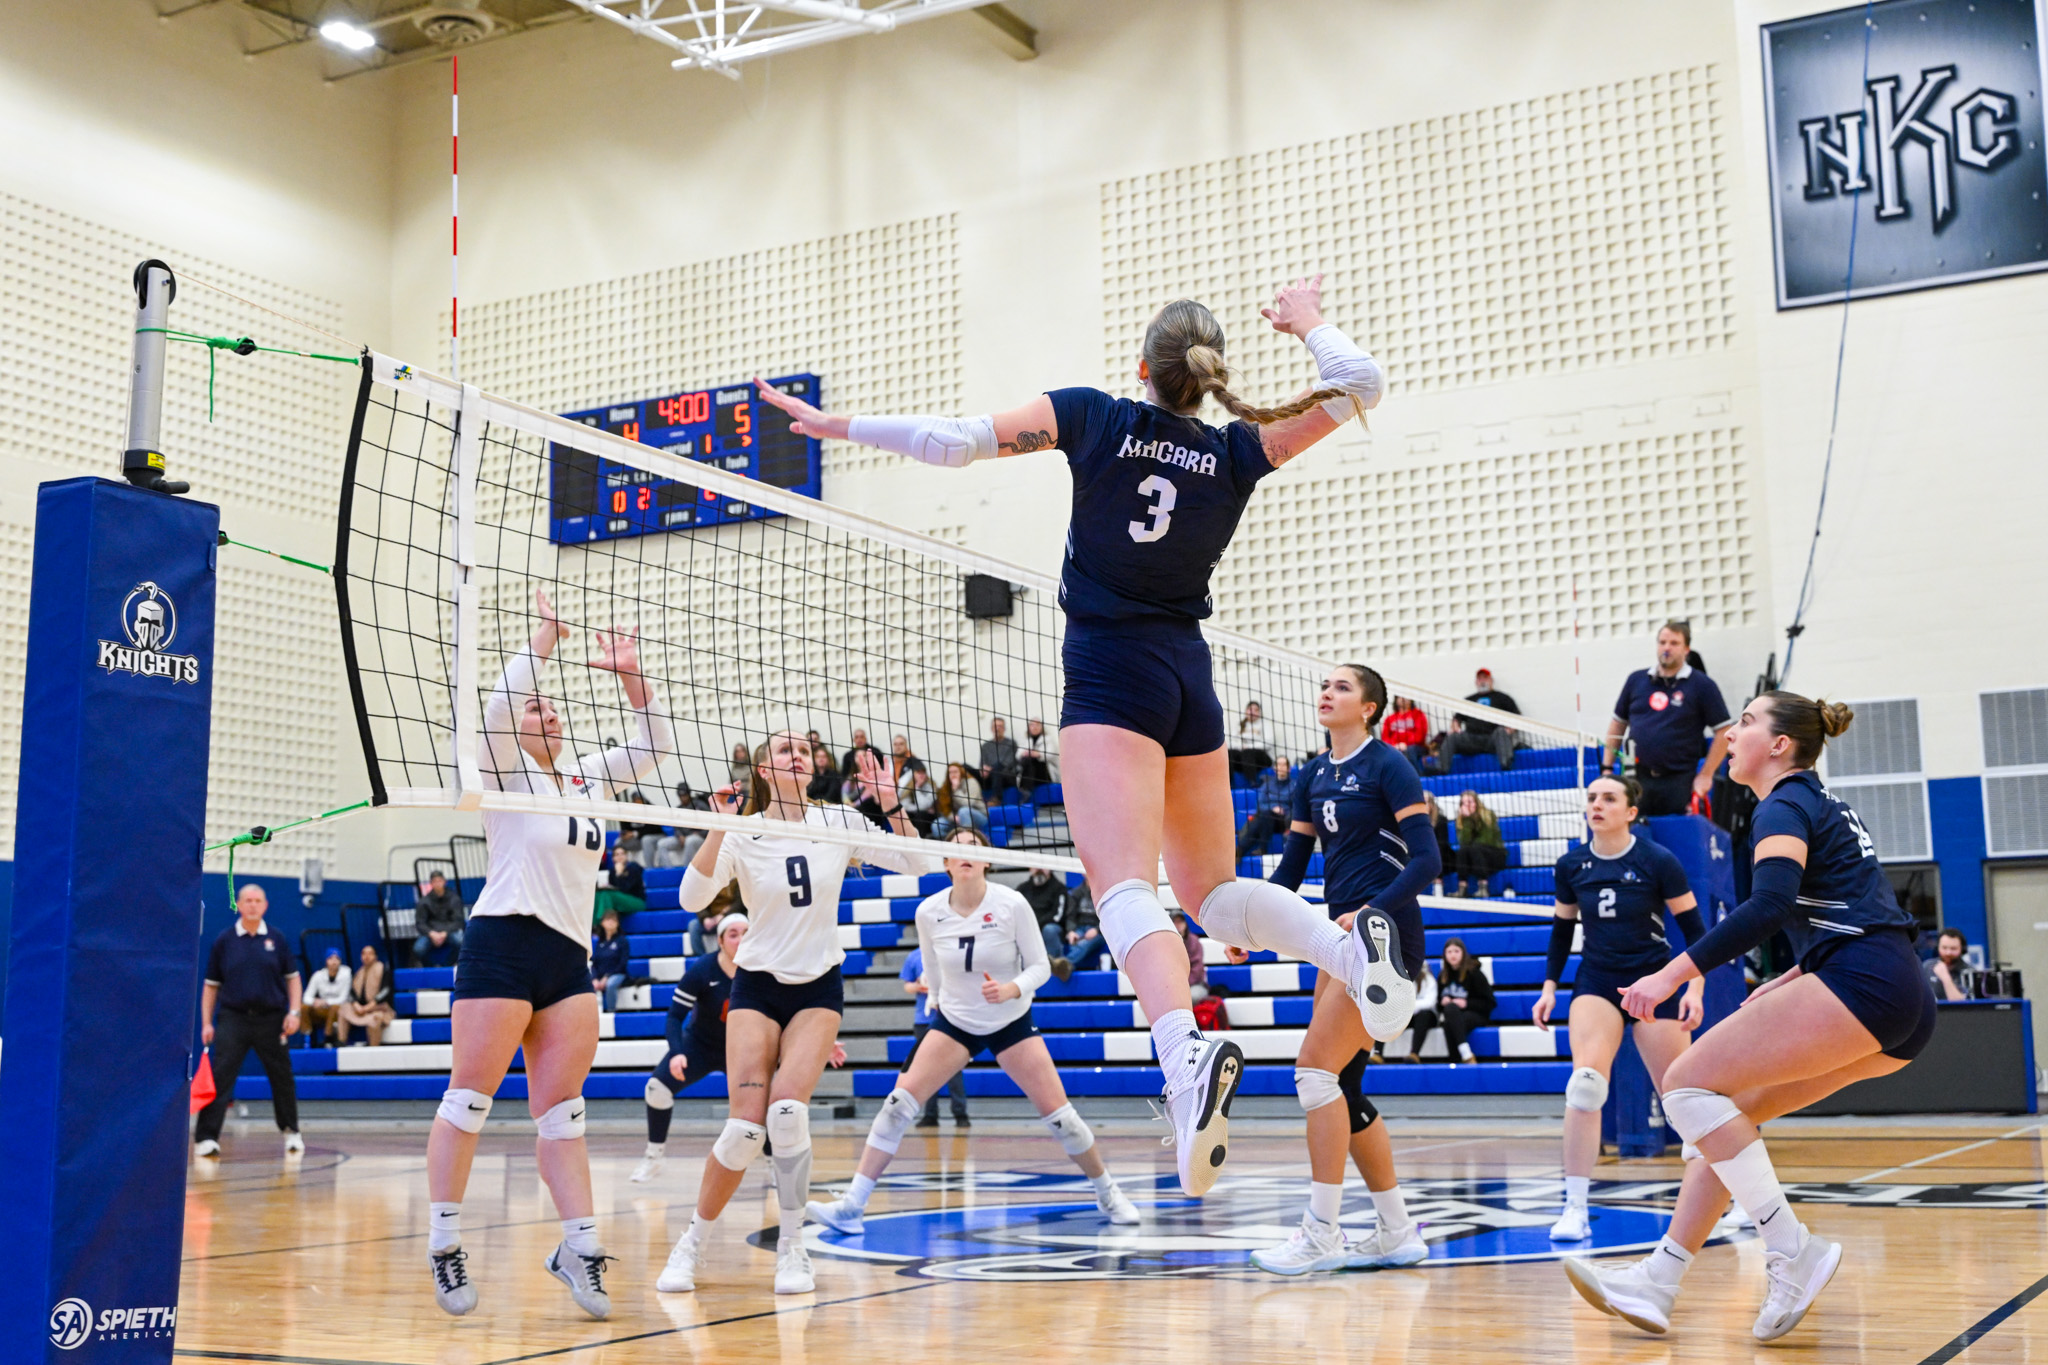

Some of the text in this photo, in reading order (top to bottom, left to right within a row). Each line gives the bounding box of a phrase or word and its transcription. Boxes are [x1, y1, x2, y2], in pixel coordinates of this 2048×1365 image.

[658, 391, 709, 425] 4:00
[734, 403, 751, 434] 5
[705, 433, 712, 454] 1
[613, 490, 627, 514] 0
[1128, 474, 1177, 543] 3
[97, 640, 199, 684] KNIGHTS
[1322, 799, 1339, 833] 8
[785, 855, 813, 908] 9
[1598, 888, 1617, 918] 2
[958, 935, 976, 973] 7
[95, 1306, 178, 1332] SPIETH
[99, 1331, 172, 1341] AMERICA
